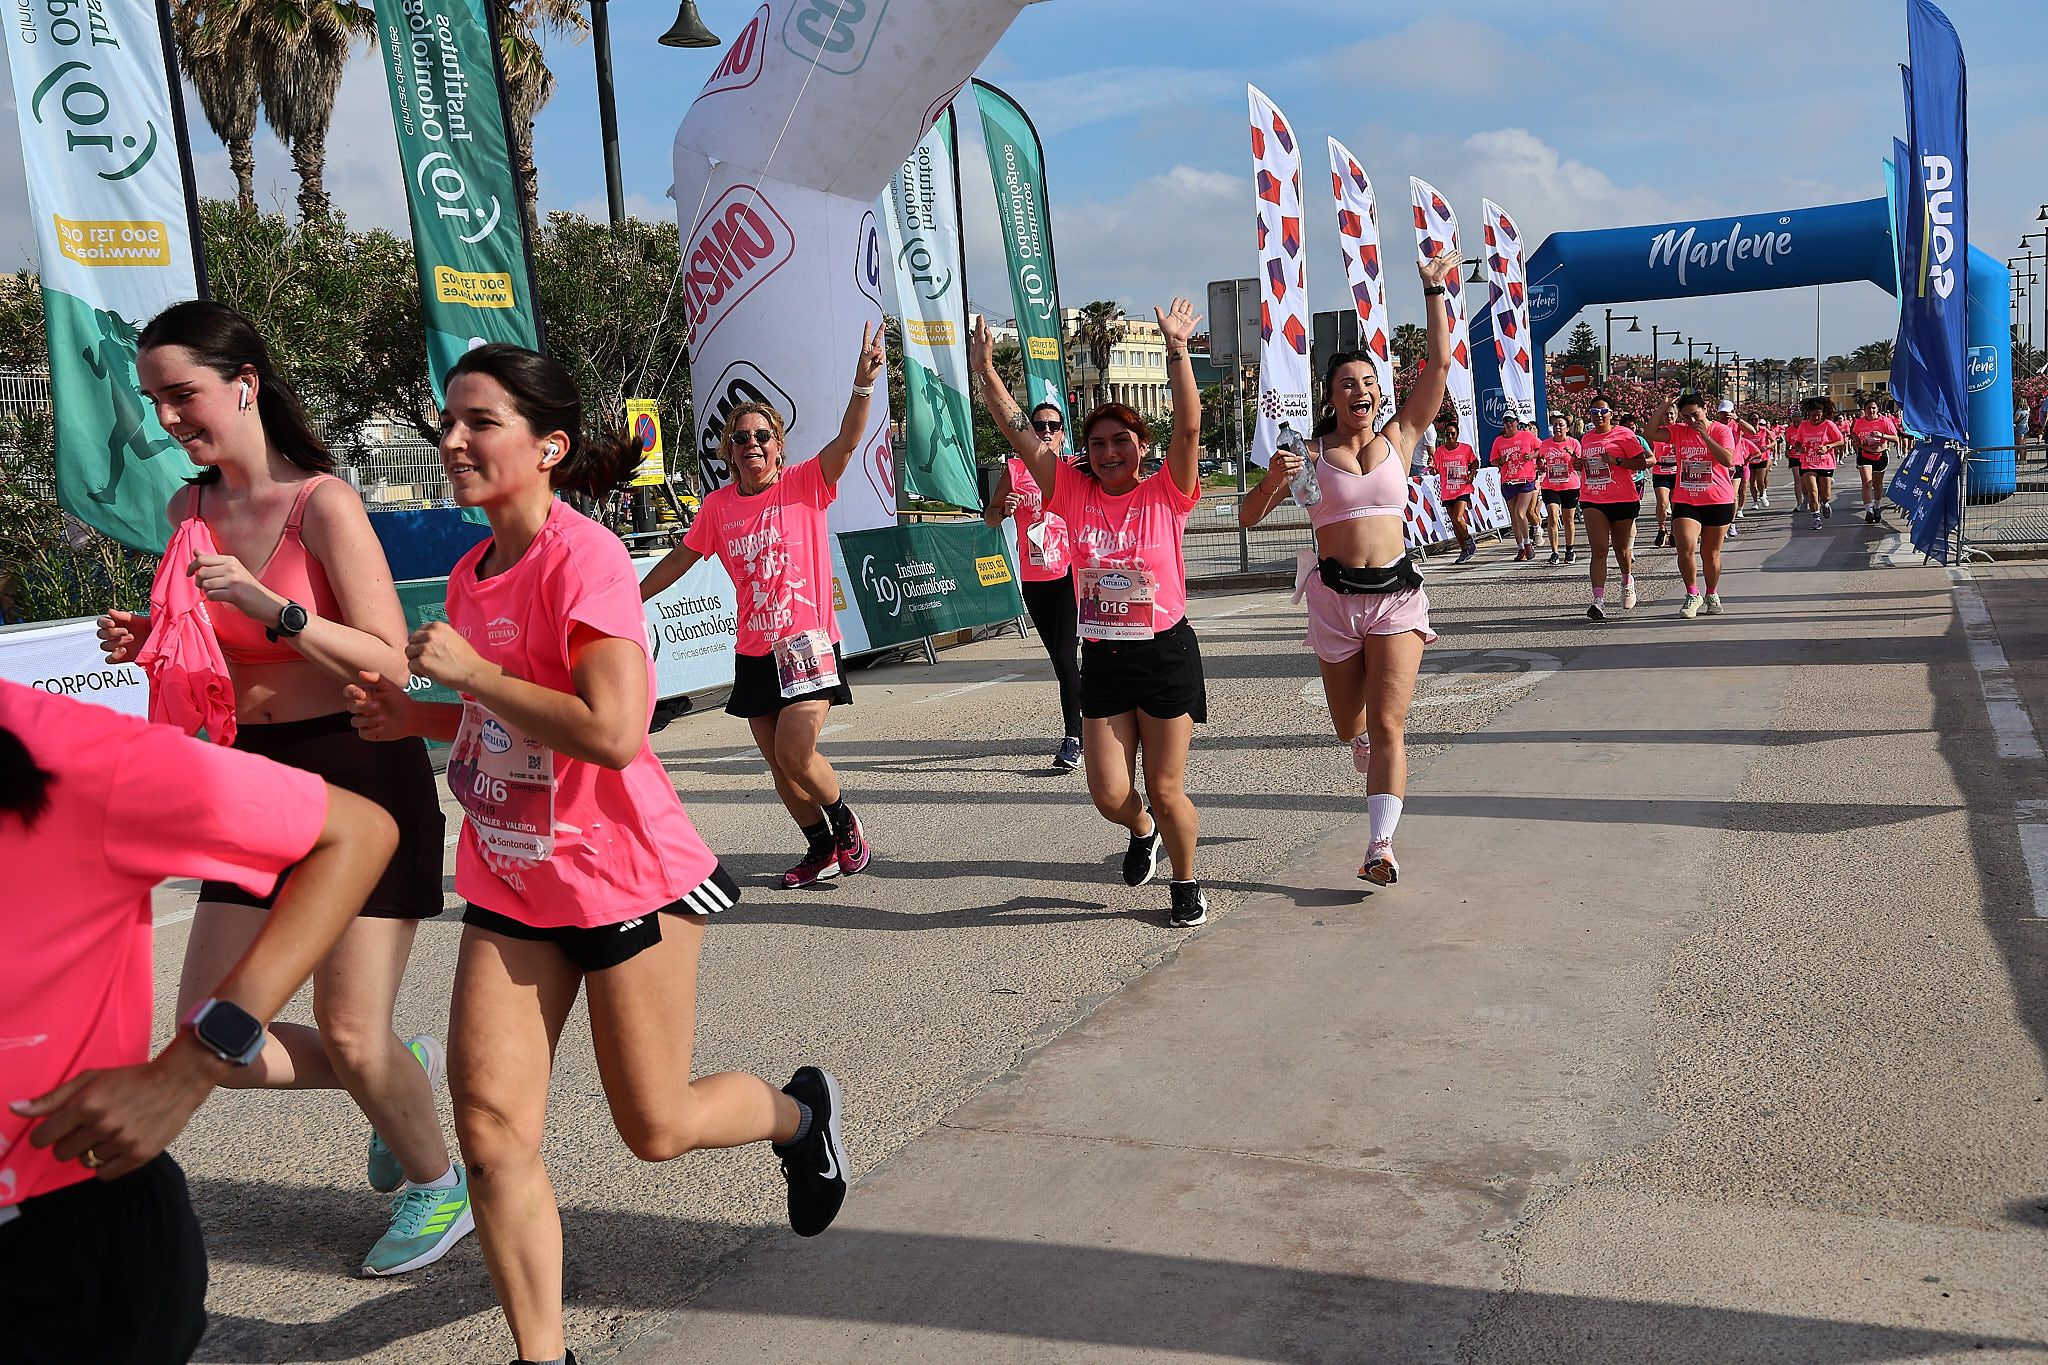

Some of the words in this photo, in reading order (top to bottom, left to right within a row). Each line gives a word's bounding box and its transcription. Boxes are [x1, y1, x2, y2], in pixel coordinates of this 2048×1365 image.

[1648, 221, 1792, 286] Marlene
[722, 519, 745, 531] OYSHO
[728, 526, 781, 557] CARRERA
[895, 560, 936, 579] Institutos
[655, 595, 722, 619] Institutos
[1100, 601, 1129, 614] 016
[664, 611, 738, 644] Odontológi
[748, 608, 793, 632] MUJER
[1084, 627, 1107, 635] OYSHO
[796, 656, 820, 671] 016
[473, 772, 508, 802] 016
[505, 821, 537, 833] VALENCIA
[497, 837, 537, 851] Santander
